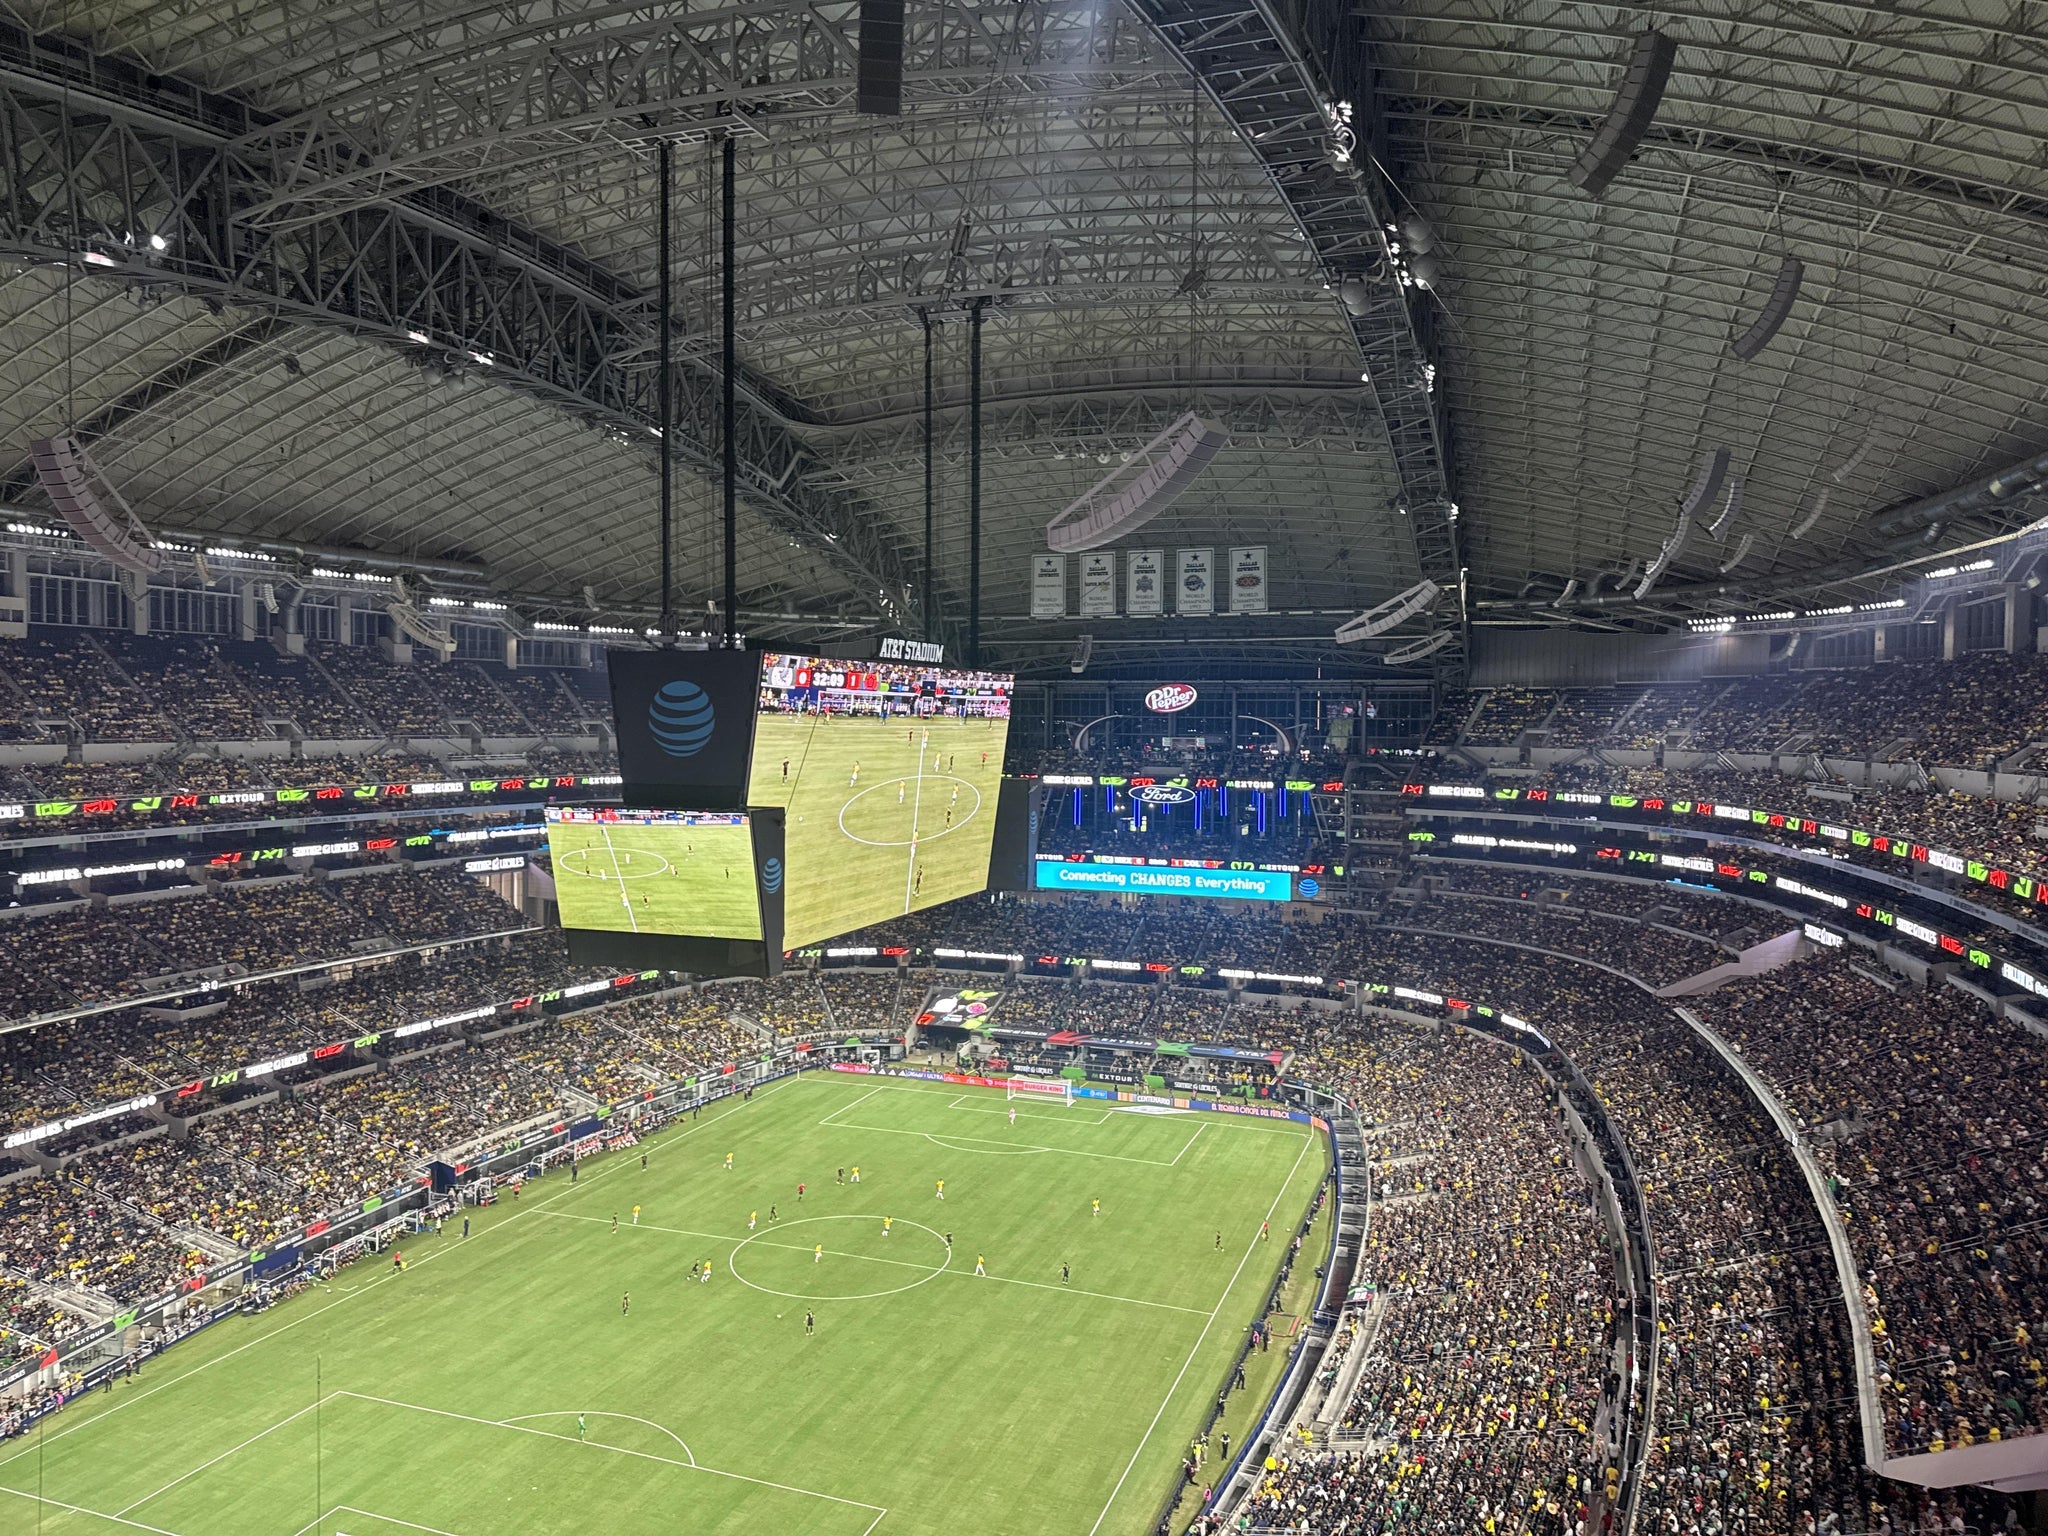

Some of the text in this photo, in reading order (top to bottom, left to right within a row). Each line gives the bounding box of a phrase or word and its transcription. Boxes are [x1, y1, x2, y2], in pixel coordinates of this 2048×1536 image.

[879, 637, 944, 663] AT&T STADIUM
[798, 671, 856, 687] 0 32:09 1
[1162, 686, 1182, 698] Dr
[1148, 689, 1193, 710] Pepper
[1226, 780, 1274, 789] MEXTOUR
[209, 792, 265, 804] MEXTOUR
[1141, 786, 1182, 801] Ford
[1556, 792, 1601, 804] MEXTOUR
[1035, 853, 1064, 861] EXTOUR
[1059, 869, 1126, 886] Connecting
[1130, 872, 1191, 887] CHANGES
[1236, 1050, 1268, 1058] AT&T
[1092, 1073, 1133, 1082] MEXTOUR
[1024, 1083, 1047, 1091] BURGER
[1260, 1108, 1270, 1117] DEL
[212, 1261, 243, 1280] MEXTOUR
[69, 1328, 106, 1350] MEXTOUR
